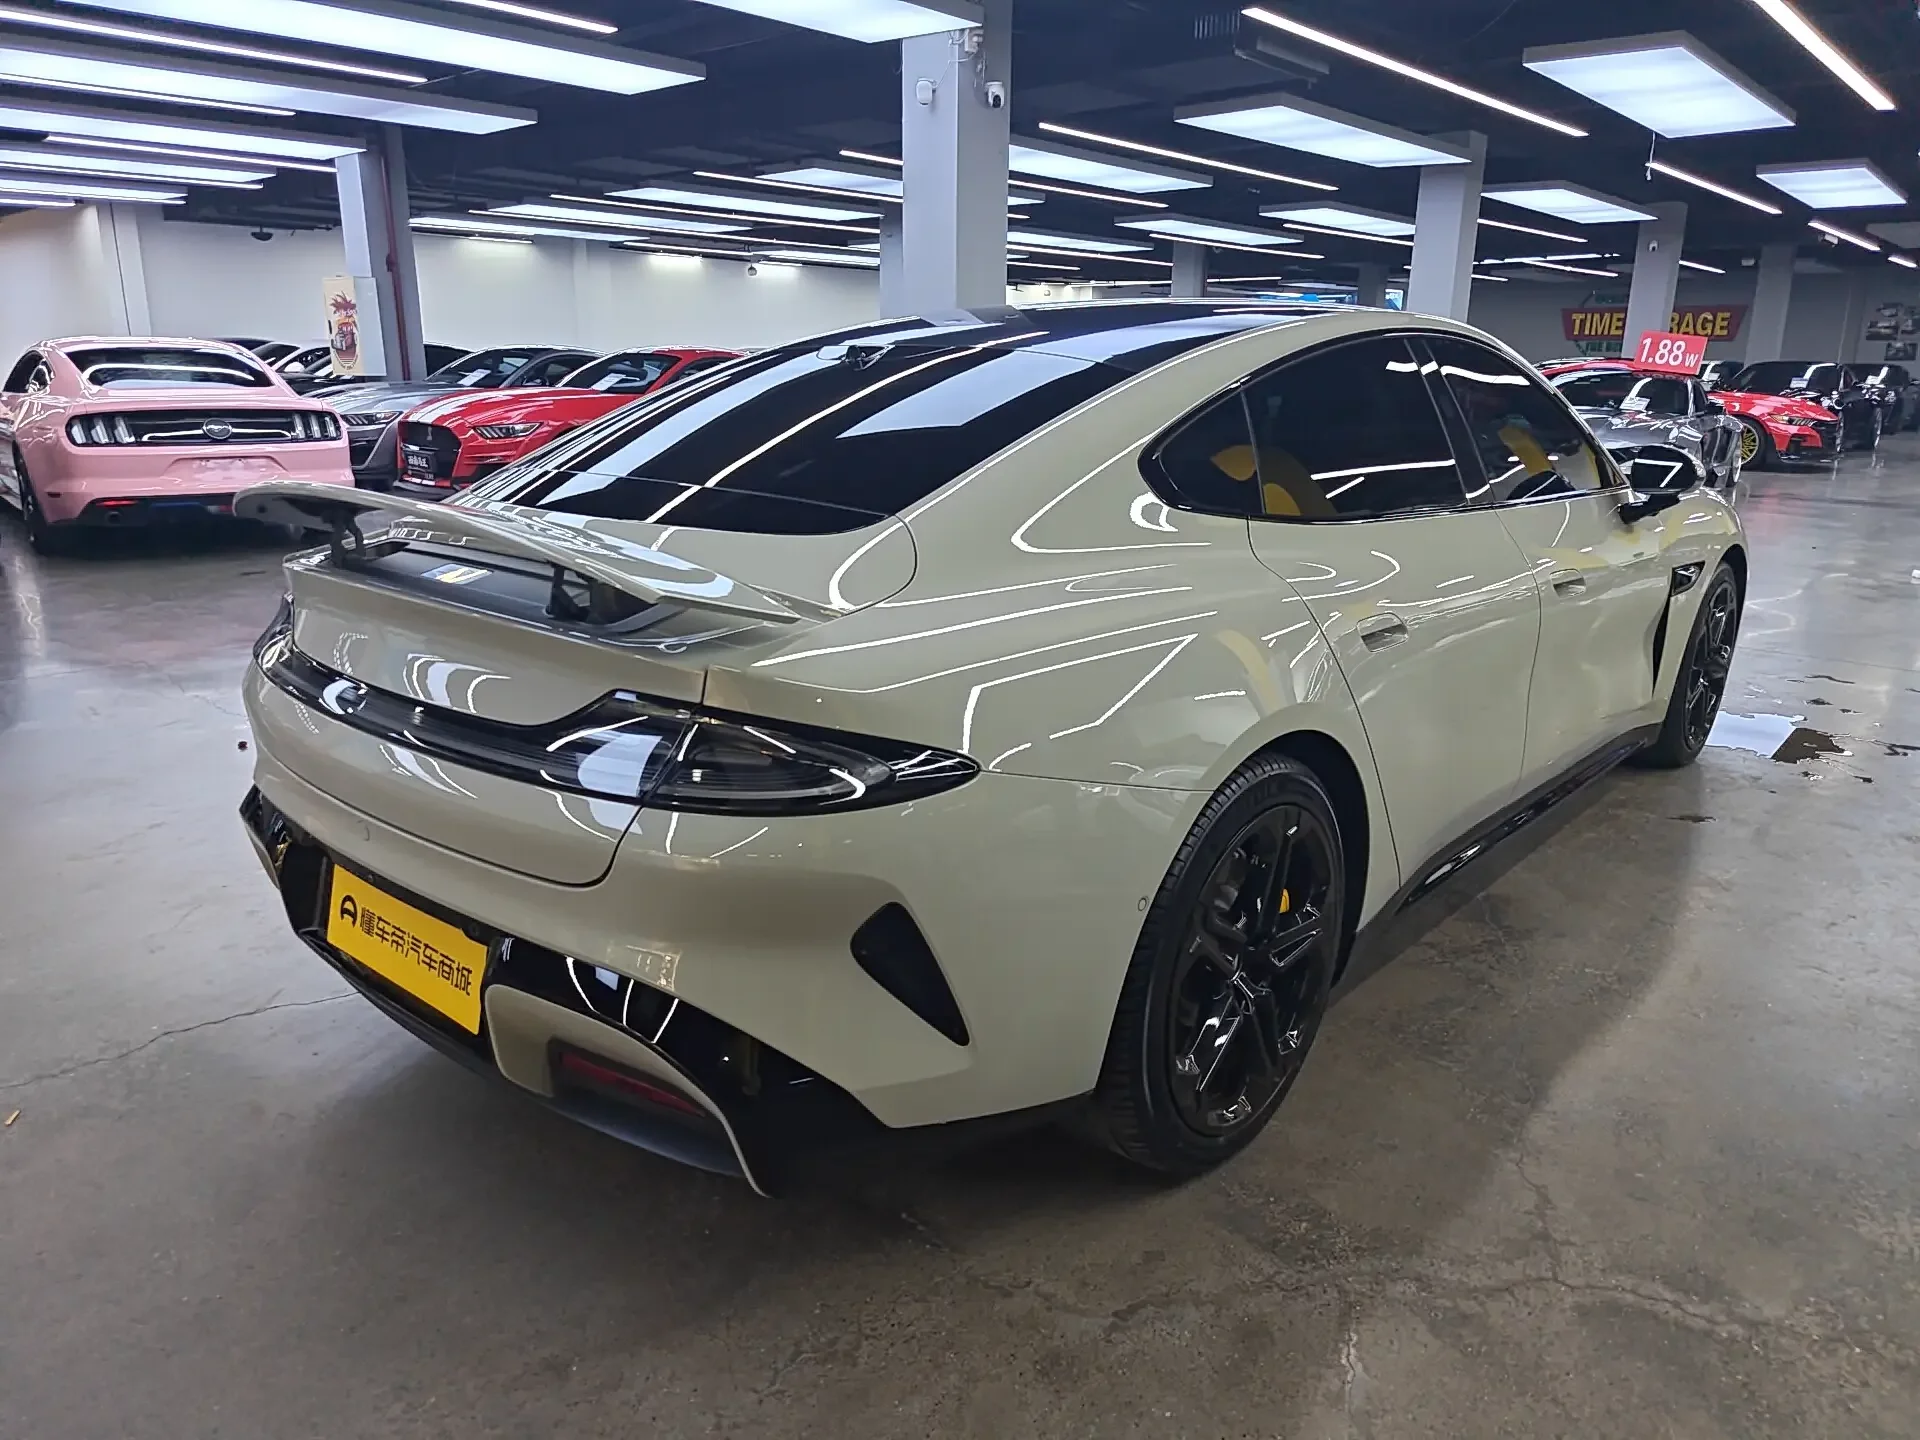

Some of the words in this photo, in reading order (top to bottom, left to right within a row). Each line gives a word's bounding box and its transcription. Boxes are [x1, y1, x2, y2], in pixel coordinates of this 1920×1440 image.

[1571, 312, 1626, 336] TIME
[1668, 312, 1731, 336] RAGE
[360, 906, 473, 996] 懂车帝汽车商城
